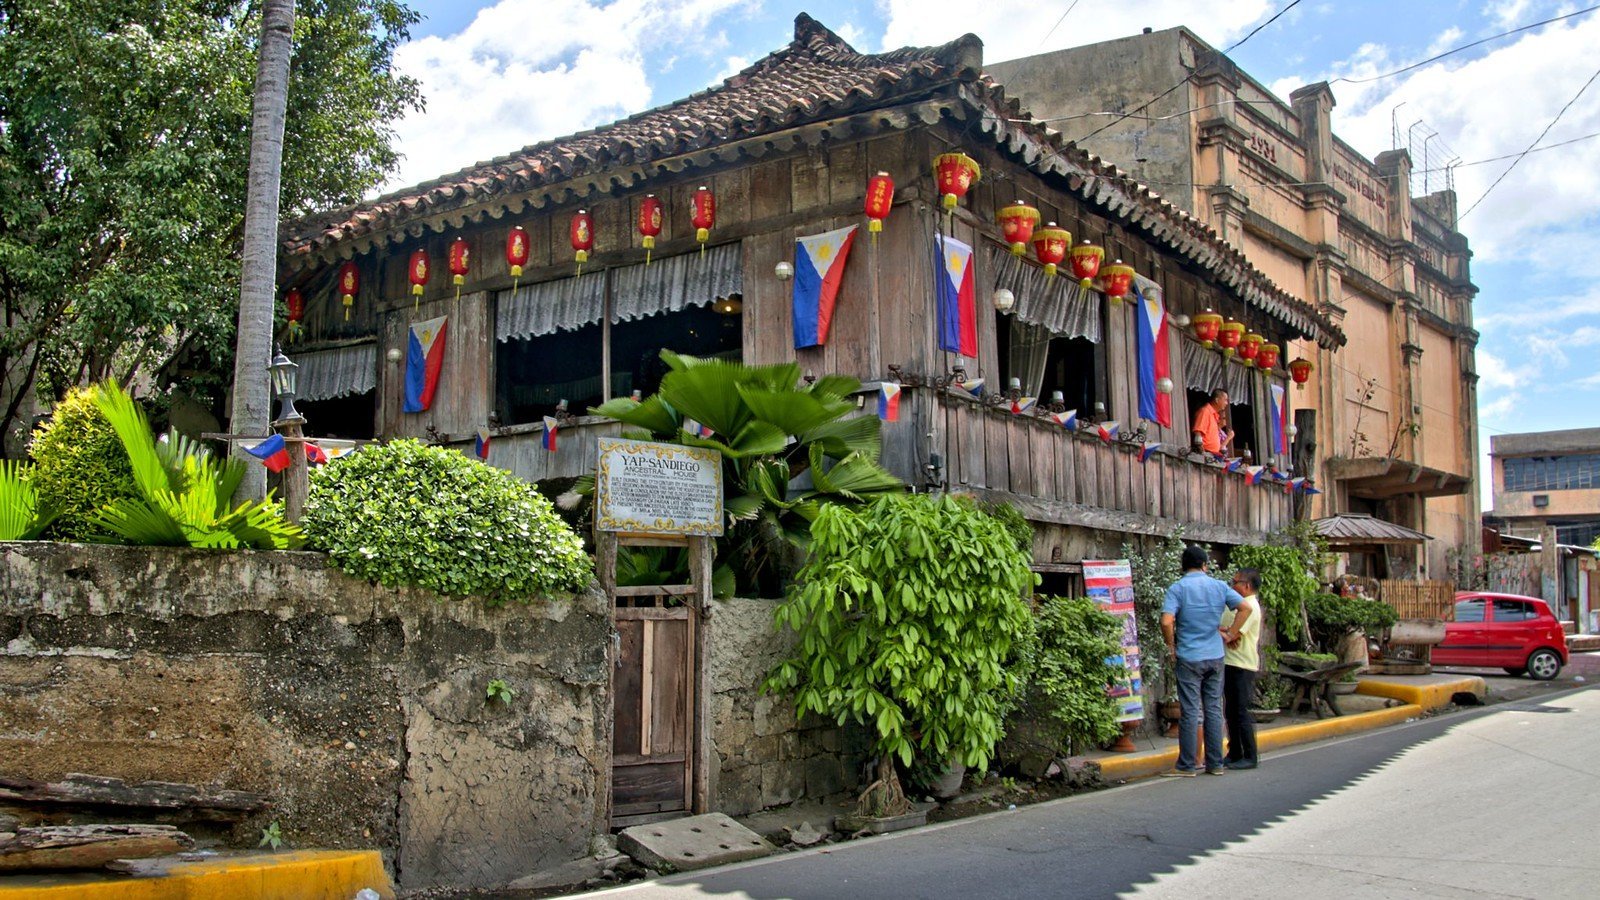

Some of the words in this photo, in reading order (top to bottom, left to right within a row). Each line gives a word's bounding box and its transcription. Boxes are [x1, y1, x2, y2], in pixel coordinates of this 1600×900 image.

[1250, 131, 1277, 164] 1931
[621, 455, 700, 472] YAP-SANDIEGO
[624, 466, 666, 475] ANCESTRAL
